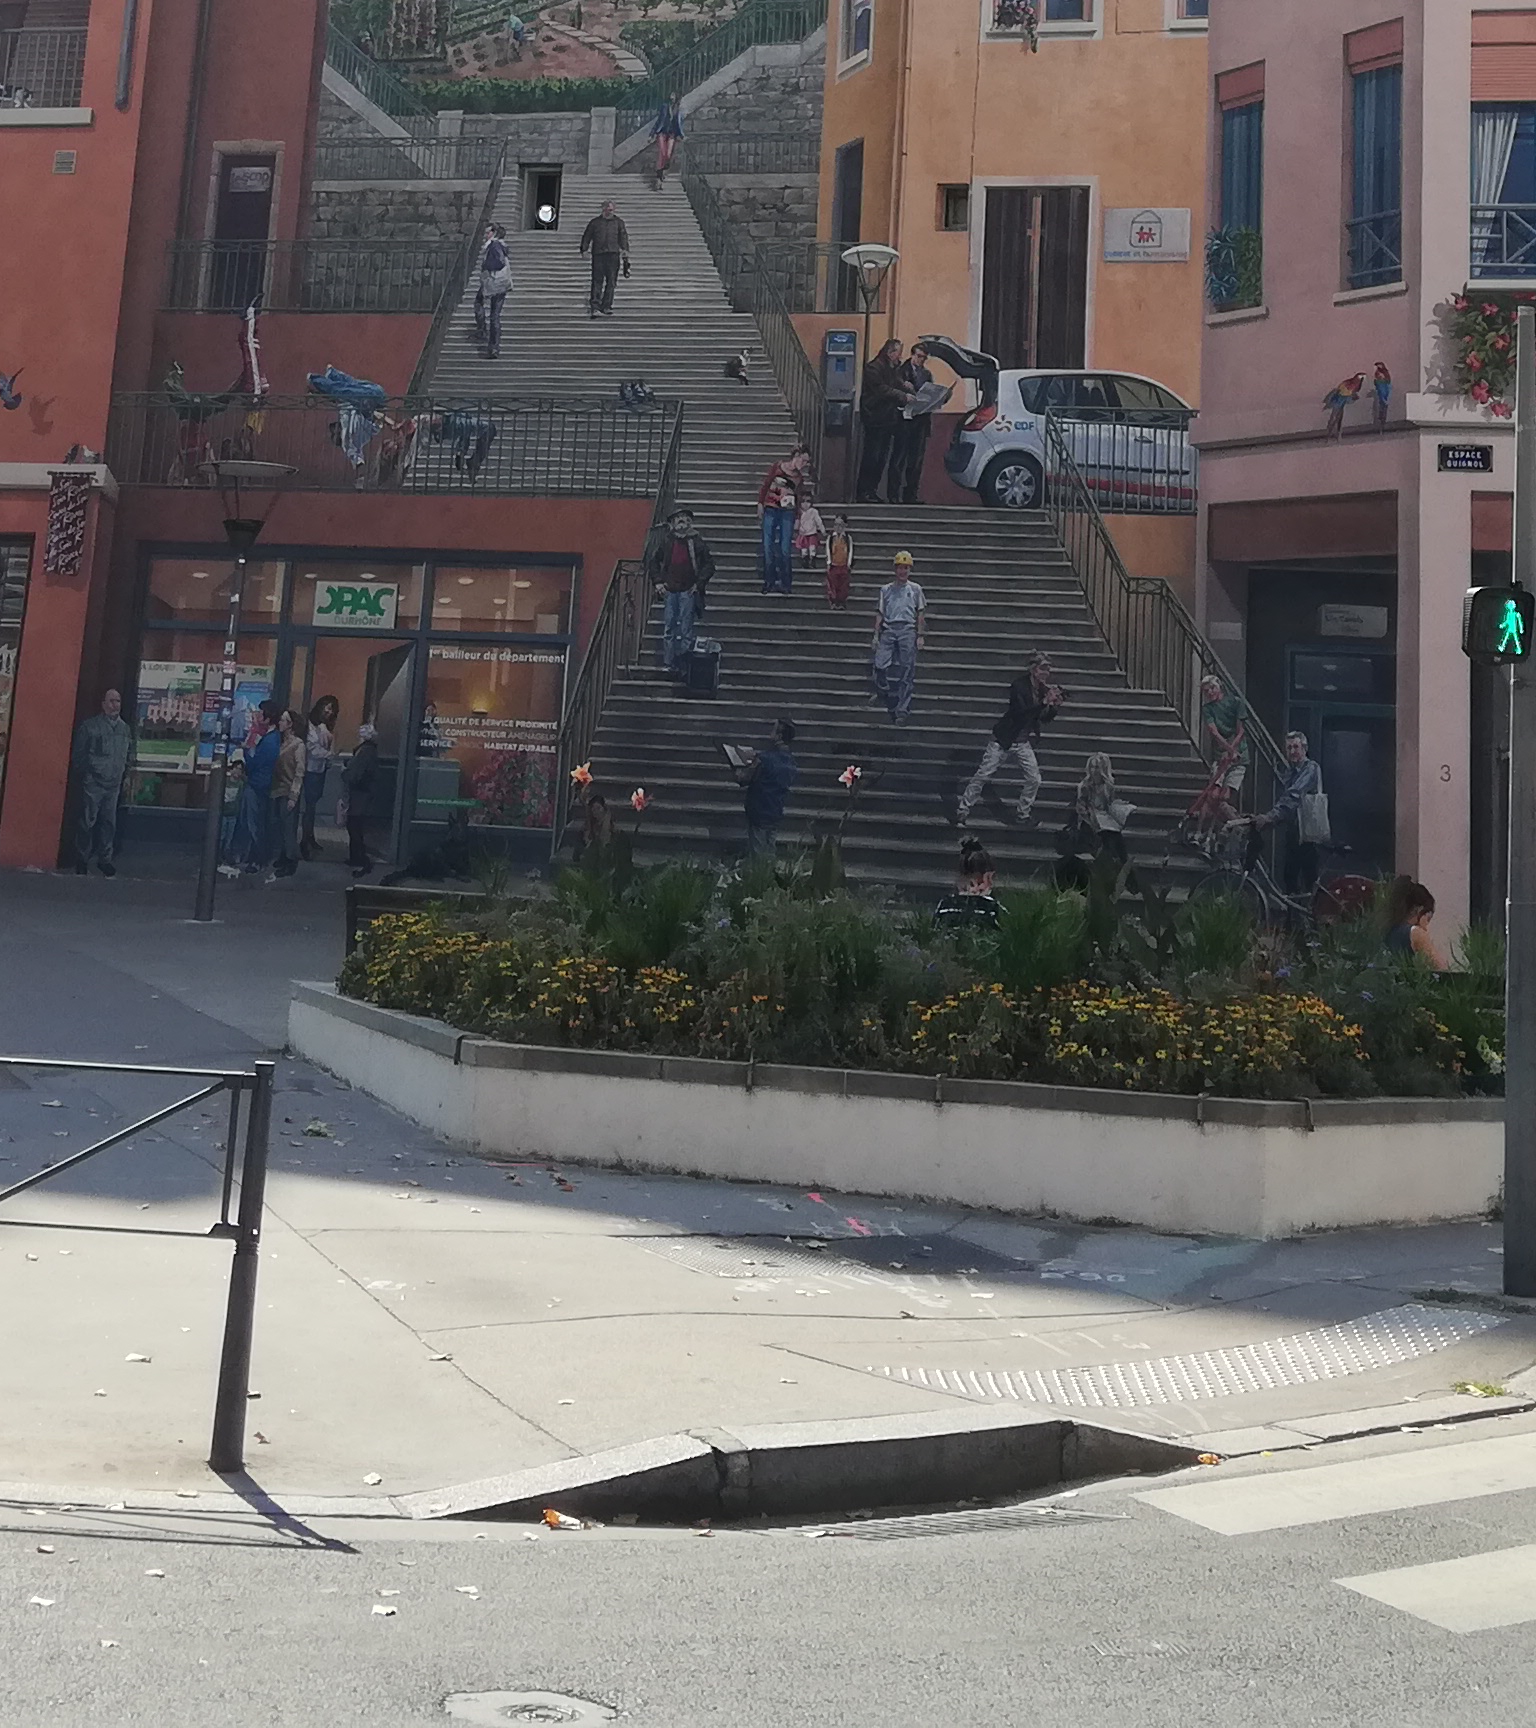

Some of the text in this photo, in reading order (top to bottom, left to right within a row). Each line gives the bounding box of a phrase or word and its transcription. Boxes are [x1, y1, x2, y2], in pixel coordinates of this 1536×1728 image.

[1448, 450, 1482, 459] ESPACE
[1446, 459, 1484, 469] GUIGNOL
[442, 649, 480, 660] bailleur
[482, 650, 498, 661] du
[498, 651, 565, 663] département
[1439, 764, 1452, 782] 3
